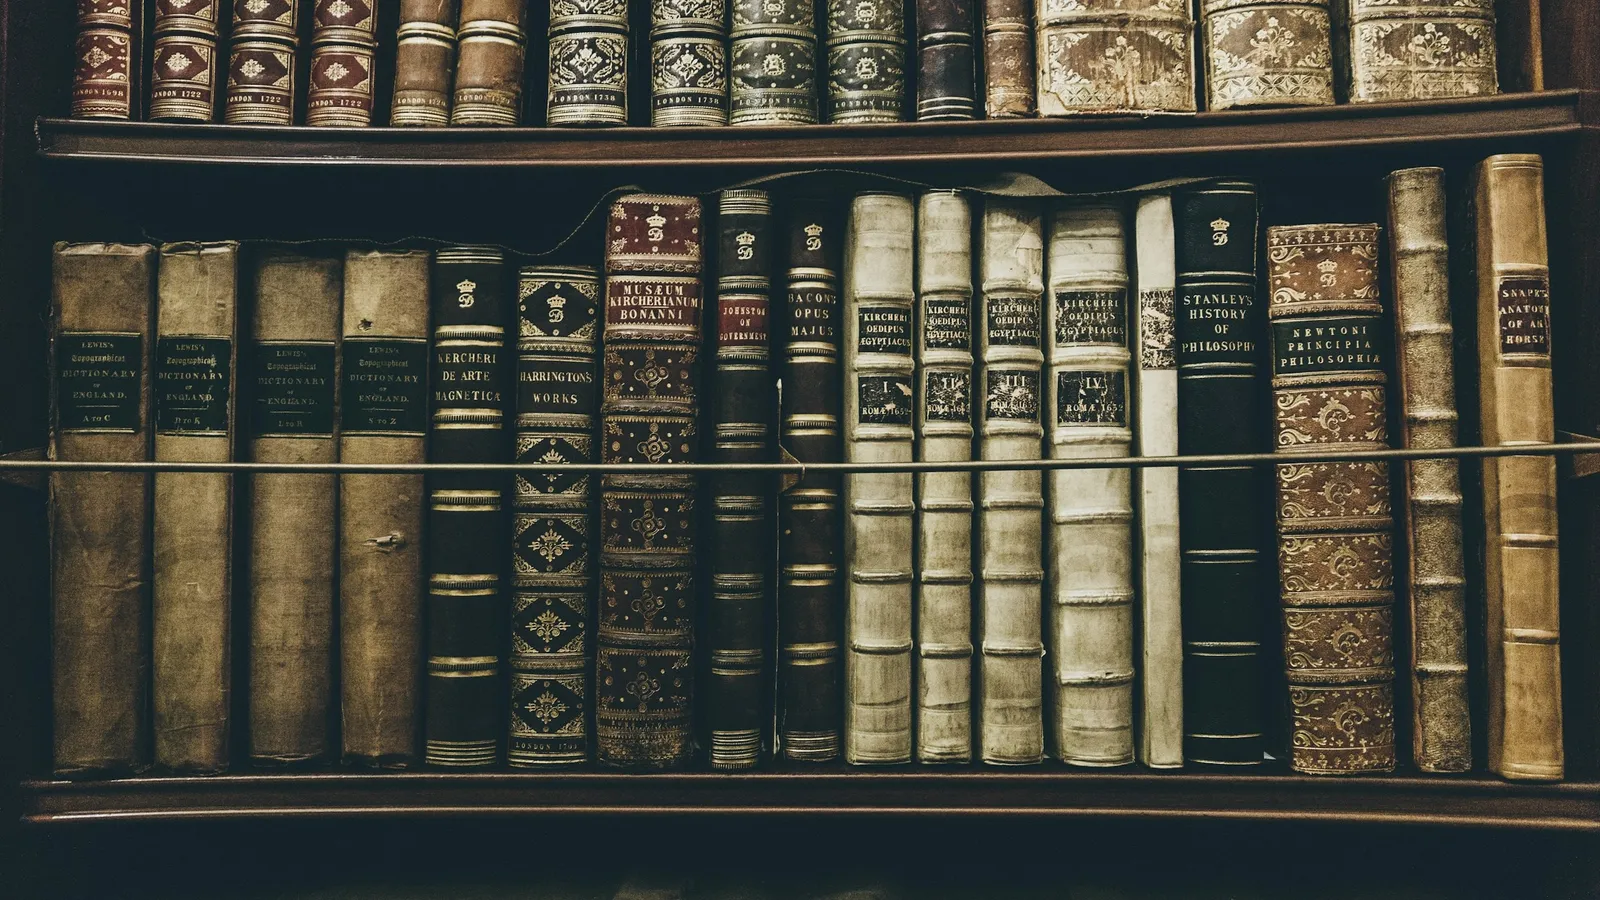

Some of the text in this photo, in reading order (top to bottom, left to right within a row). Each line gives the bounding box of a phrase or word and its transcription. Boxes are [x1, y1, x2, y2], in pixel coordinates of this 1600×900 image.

[101, 89, 124, 97] 1698
[151, 90, 202, 98] ONDON 1722
[260, 95, 281, 103] 1722
[339, 99, 362, 107] 1722
[554, 94, 616, 103] LONDON 1738
[657, 96, 720, 105] LONDON 1738
[739, 97, 781, 106] LONDON
[836, 99, 874, 109] LONDON
[623, 284, 684, 296] MUSÆUM
[610, 295, 699, 308] KIRCHERIANUM
[1063, 299, 1119, 308] KIRCHERI
[1183, 293, 1253, 306] STANLEY'S
[620, 309, 683, 320] BONANNI
[794, 308, 829, 319] OPUS
[928, 306, 968, 315] KIRCHERI
[1189, 308, 1246, 320] HISTORY
[864, 313, 907, 322] KIRCHERI
[995, 316, 1034, 325] OEDIPUS
[1068, 312, 1116, 321] OEDIPUS
[739, 317, 751, 327] ON
[932, 317, 967, 326] OEDIPUS
[1508, 319, 1544, 329] OF AN
[791, 325, 833, 337] MAJUS
[866, 324, 904, 334] OEDIPUS
[1214, 323, 1230, 334] OF
[1293, 325, 1367, 338] NEWTONI
[719, 331, 767, 341] GOVERNMENT
[1505, 335, 1545, 344] HORSE
[81, 341, 115, 349] LEWIS's
[859, 336, 911, 347] ÆGYPTIACUS
[1287, 340, 1372, 352] PRINCIPIA
[176, 344, 205, 352] LEWIS's
[1181, 340, 1256, 353] PHILOSOPHY
[62, 369, 137, 378] DICTIONARY
[158, 372, 224, 380] DICTIONARY
[442, 370, 491, 381] DE ARTE
[520, 371, 593, 384] HARRINGTON'S
[257, 377, 326, 385] DICTIONARY
[349, 374, 419, 383] DICTIONARY
[941, 376, 956, 389] II
[1005, 375, 1026, 387] III
[72, 391, 128, 399] ENGLAND.
[166, 393, 215, 402] ENGLAND.
[358, 394, 410, 403] ENGLAND.
[532, 392, 578, 405] WORKS
[267, 397, 318, 405] ENGLAND.
[104, 414, 111, 422] C
[194, 416, 201, 425] K
[389, 417, 397, 425] Z
[516, 740, 551, 750] LONDON
